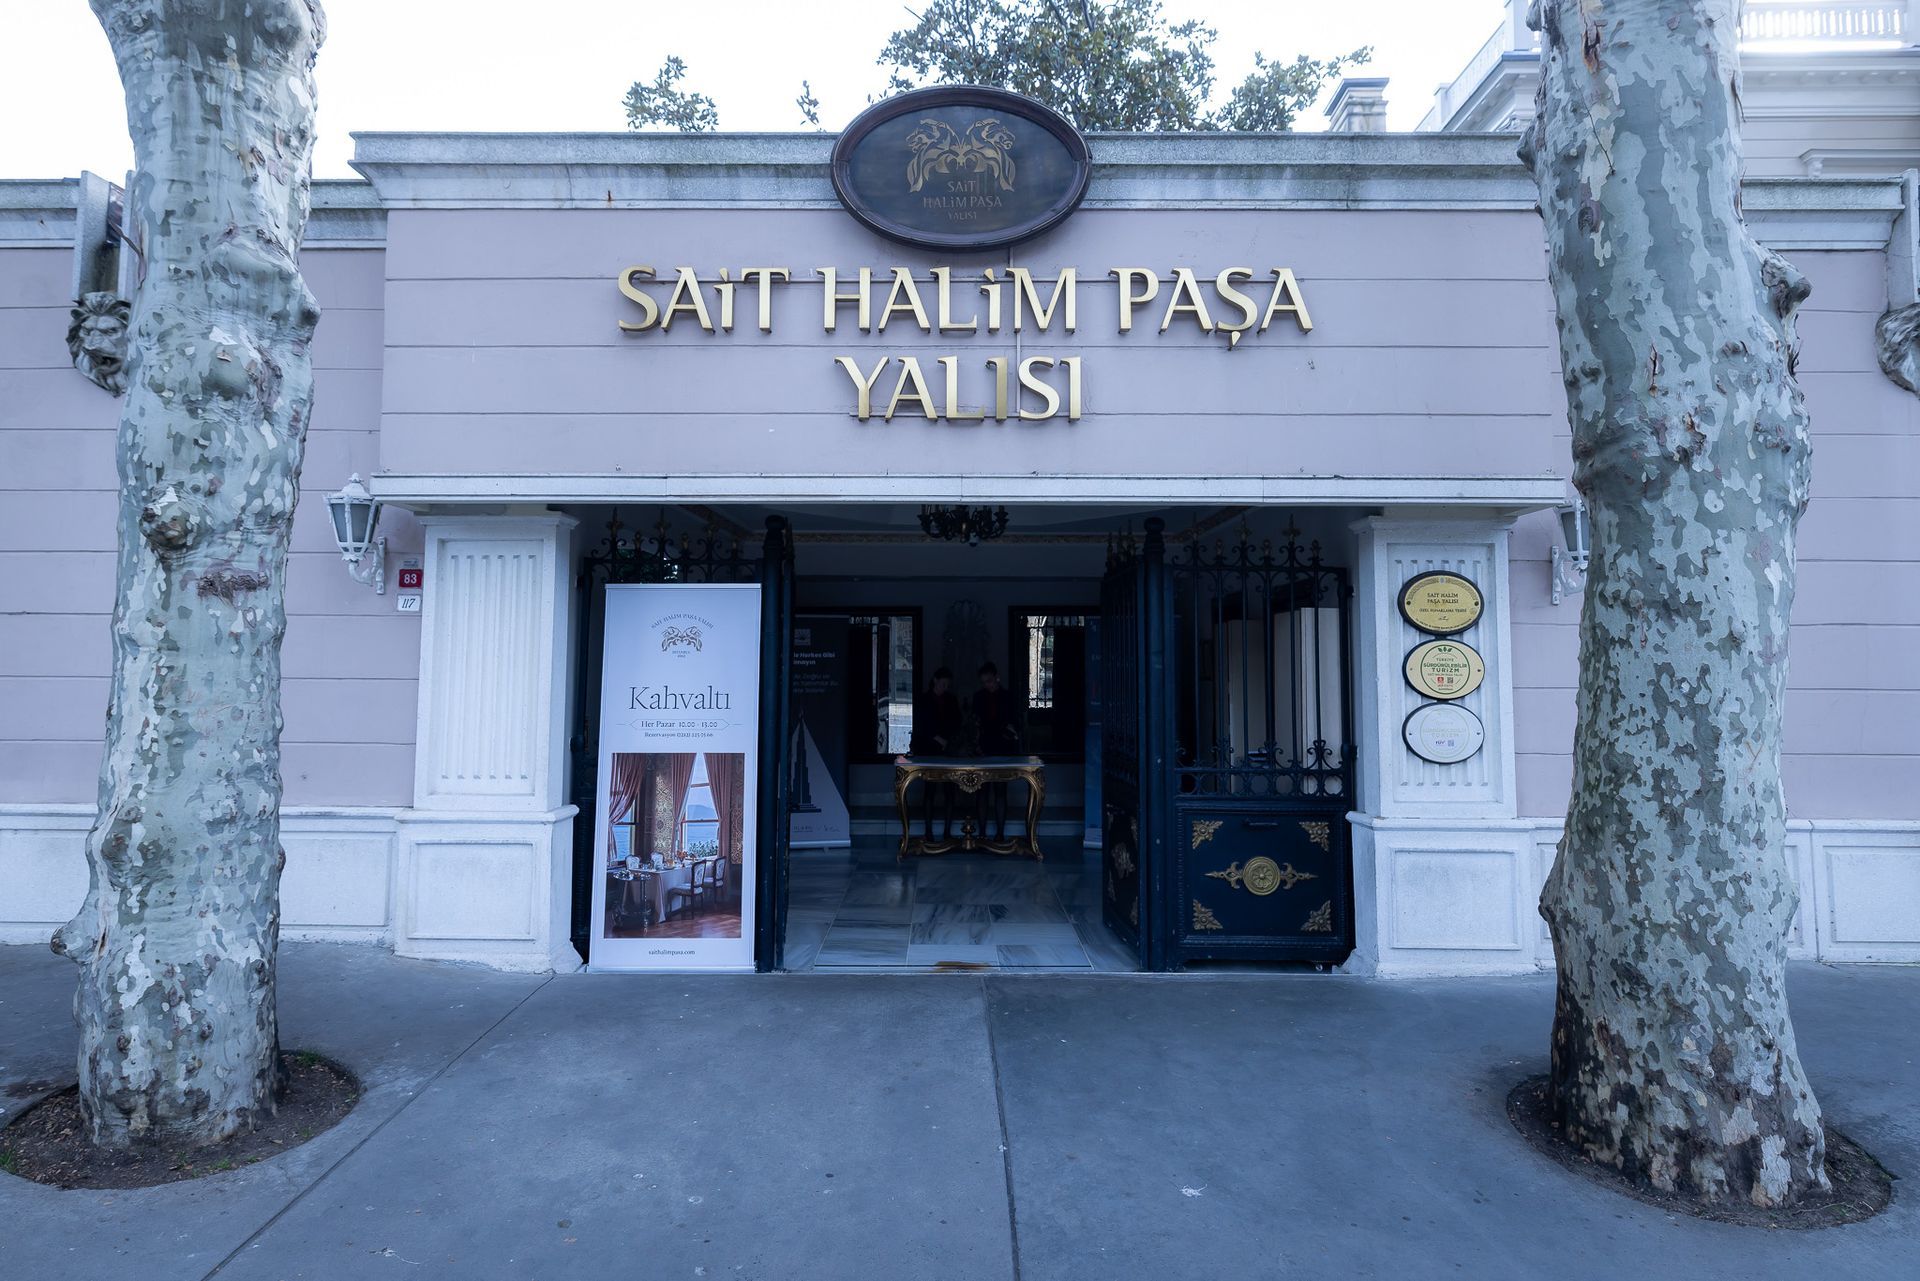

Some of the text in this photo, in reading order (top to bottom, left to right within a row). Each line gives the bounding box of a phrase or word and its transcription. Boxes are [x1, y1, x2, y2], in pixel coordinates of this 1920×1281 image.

[970, 195, 1002, 211] PAŞA
[1109, 266, 1314, 349] PAŞA
[834, 356, 1082, 423] YALISI
[404, 573, 417, 584] 83
[402, 598, 416, 609] 117
[629, 685, 732, 710] Kahvaltı
[641, 720, 654, 728] Her
[656, 720, 676, 728] Pazar
[701, 721, 718, 729] 13.00
